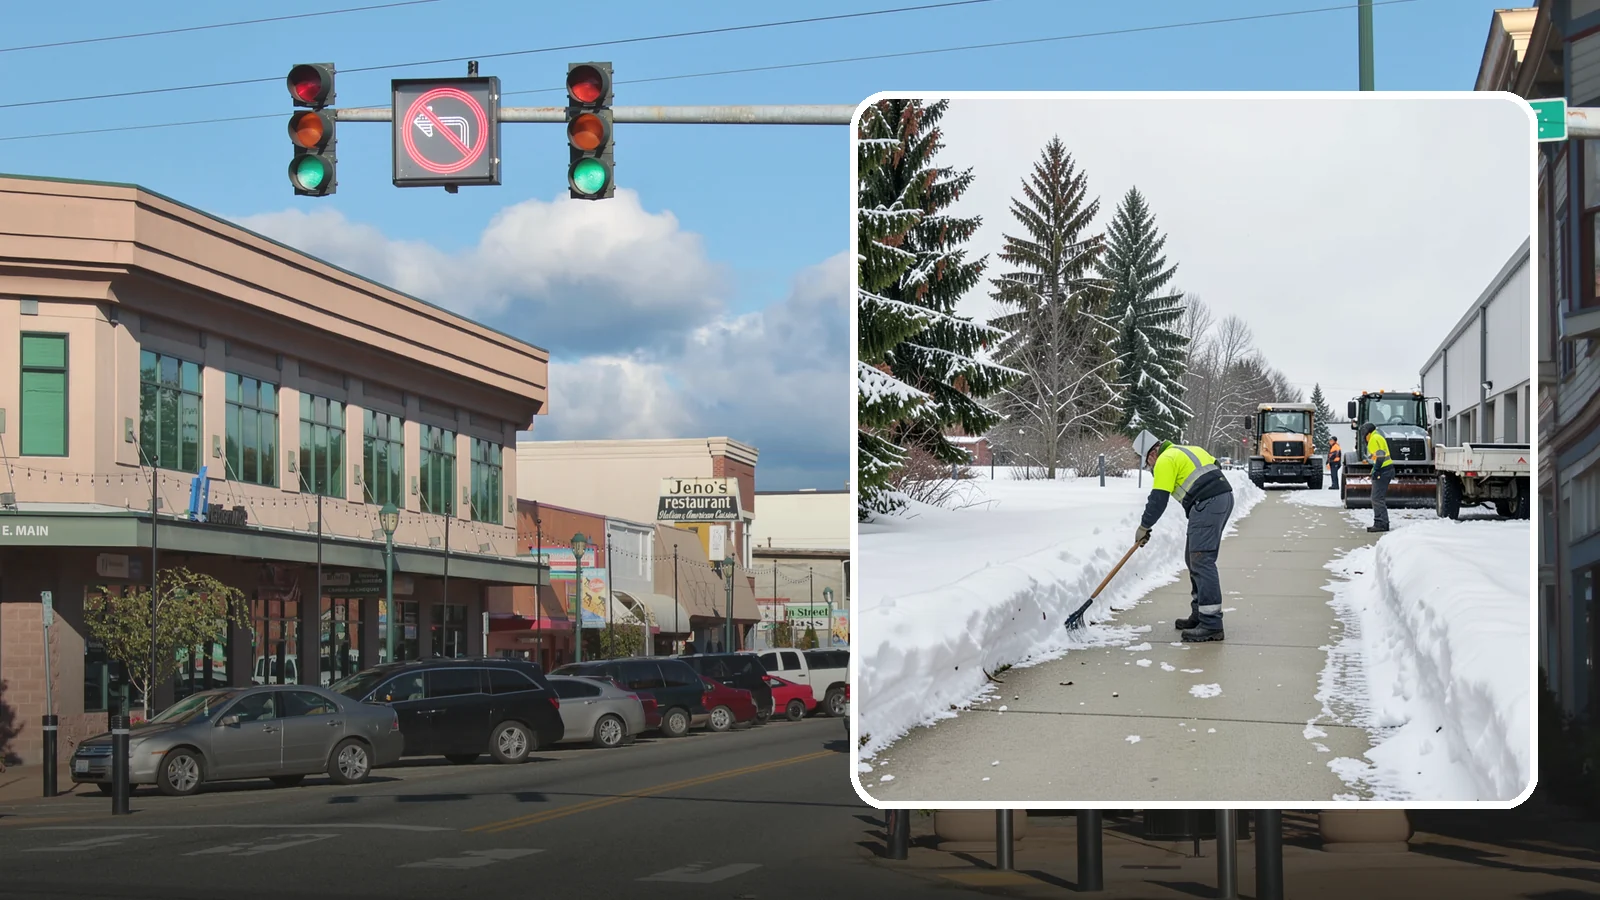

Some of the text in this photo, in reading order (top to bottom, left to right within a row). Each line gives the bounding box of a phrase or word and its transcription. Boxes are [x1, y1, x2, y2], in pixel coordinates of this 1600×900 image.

[670, 480, 728, 494] Jeno's
[665, 496, 731, 508] restaurant
[658, 509, 681, 519] Italian
[686, 509, 714, 519] American
[714, 509, 738, 519] Cuisine
[2, 525, 49, 536] E. MAIN
[797, 607, 829, 617] Street
